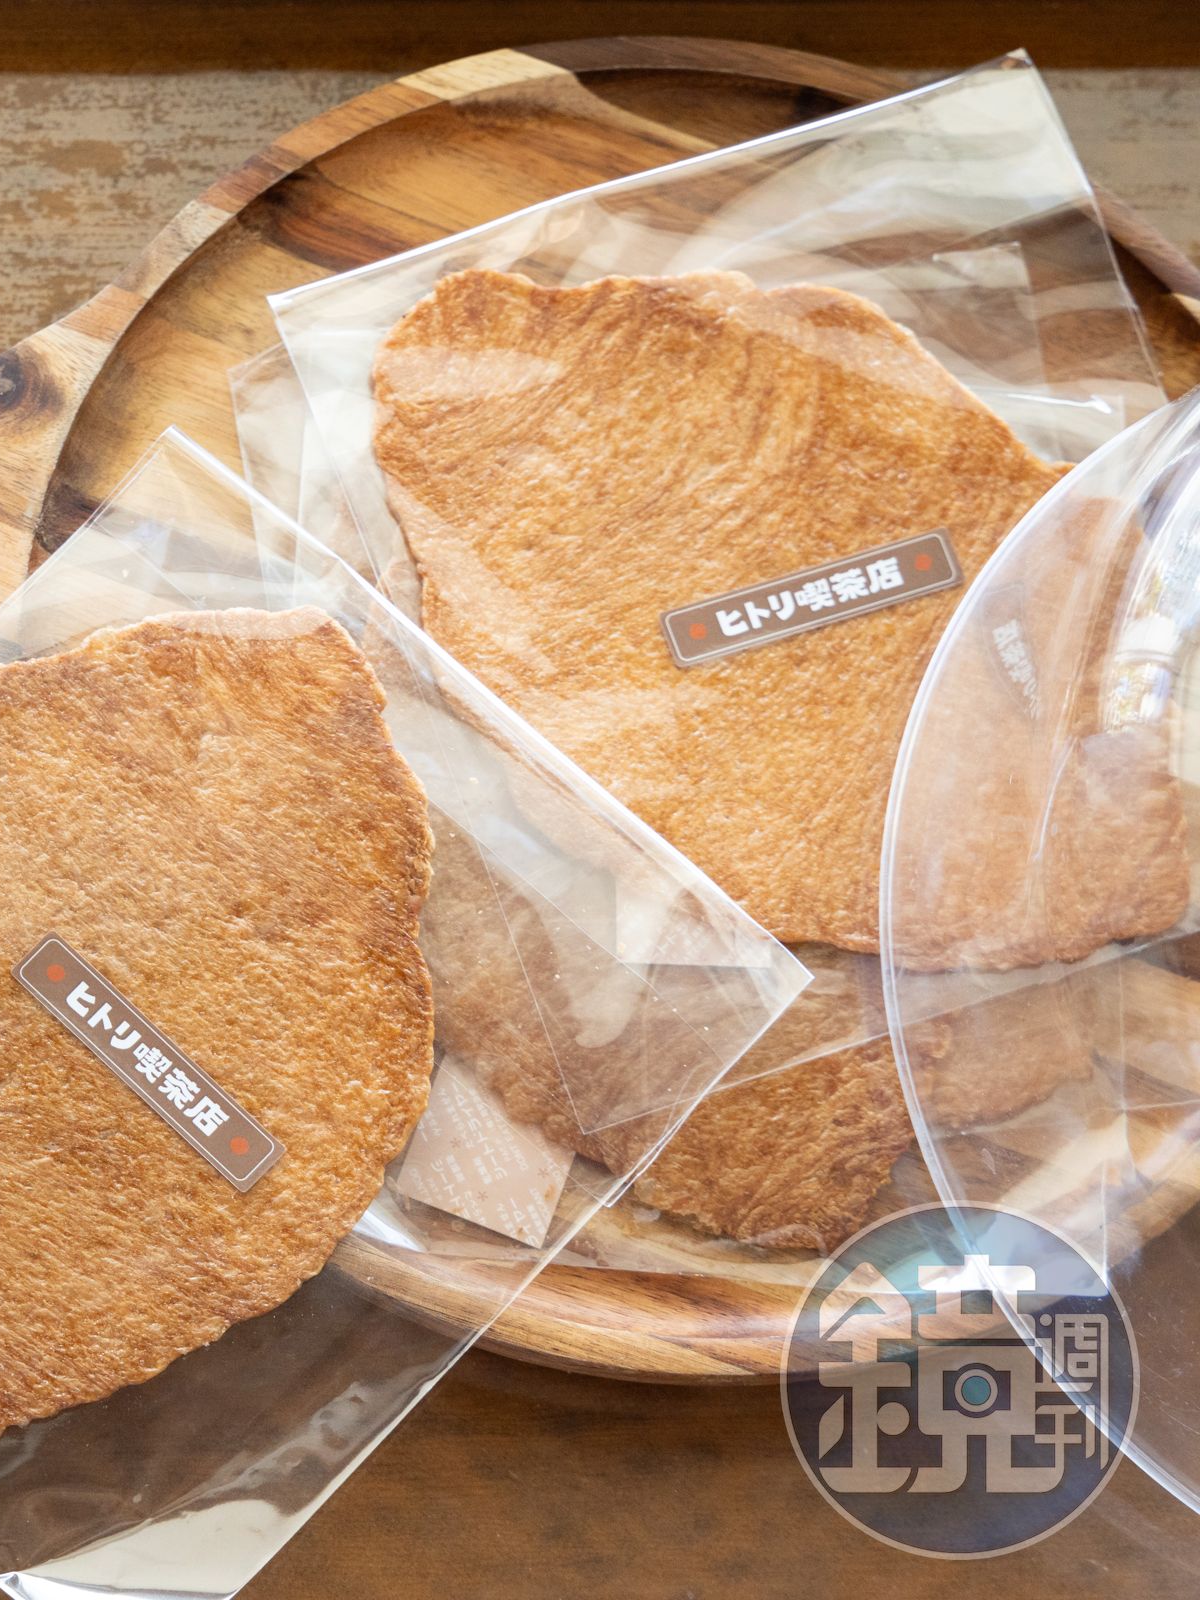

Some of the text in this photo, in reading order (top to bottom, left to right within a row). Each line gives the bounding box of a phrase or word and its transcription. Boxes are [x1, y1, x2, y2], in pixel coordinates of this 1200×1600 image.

[715, 557, 905, 637] ヒトリ喫茶店
[66, 981, 230, 1137] ヒトリ喫茶店
